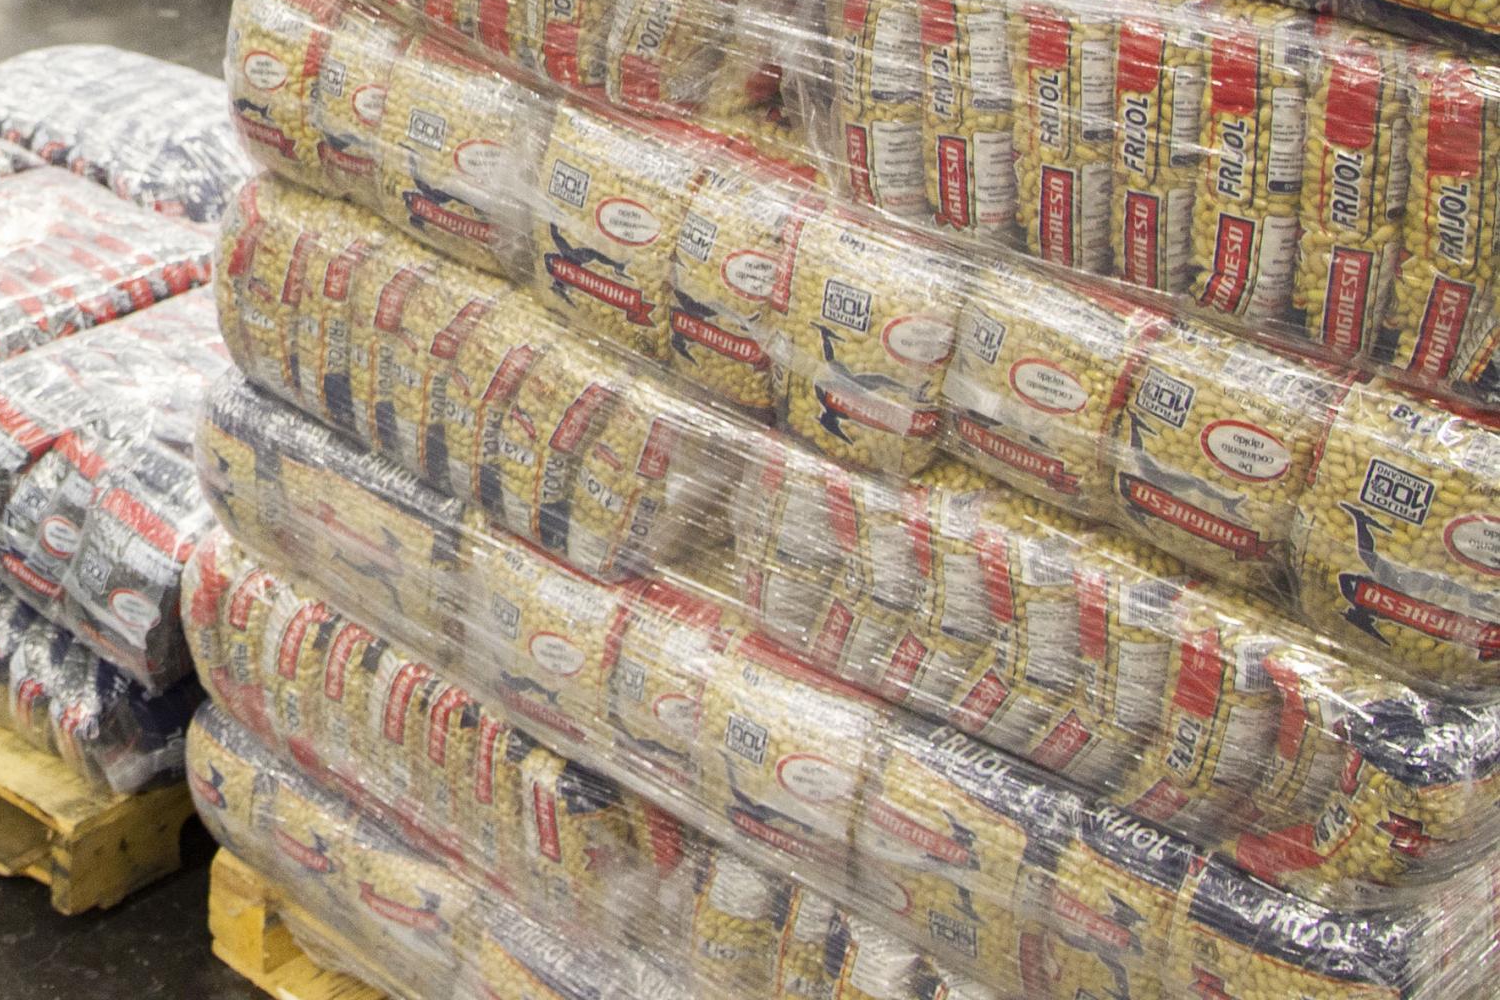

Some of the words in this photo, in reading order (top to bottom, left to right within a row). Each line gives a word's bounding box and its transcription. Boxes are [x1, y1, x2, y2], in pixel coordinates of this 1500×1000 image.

[932, 46, 954, 118] FRIJOL
[1040, 71, 1060, 150] FRIJOL
[1124, 96, 1149, 174] FRIJOL
[1217, 119, 1247, 198] FRIJOL
[1049, 176, 1065, 260] OGRESO
[1331, 151, 1363, 230] FRIJOL
[1133, 202, 1149, 286] OGRESO
[1436, 182, 1469, 264] FRIJOL
[554, 257, 635, 308] PROGRESO
[1334, 260, 1363, 350] OGRESO
[1421, 289, 1462, 378] OGRESO
[1138, 397, 1180, 425] FRIJOL
[1148, 372, 1190, 397] MEXICAN
[960, 418, 1057, 477] PROGRESO
[1221, 442, 1276, 466] cocimiento
[1232, 433, 1265, 451] rápido
[1237, 461, 1254, 474] De
[1369, 492, 1419, 520] FRIJOL
[1370, 475, 1426, 511] 100%
[1375, 465, 1427, 493] MEXICANO
[1135, 485, 1249, 547] PROGRESO
[1099, 805, 1170, 861] RIJOL
